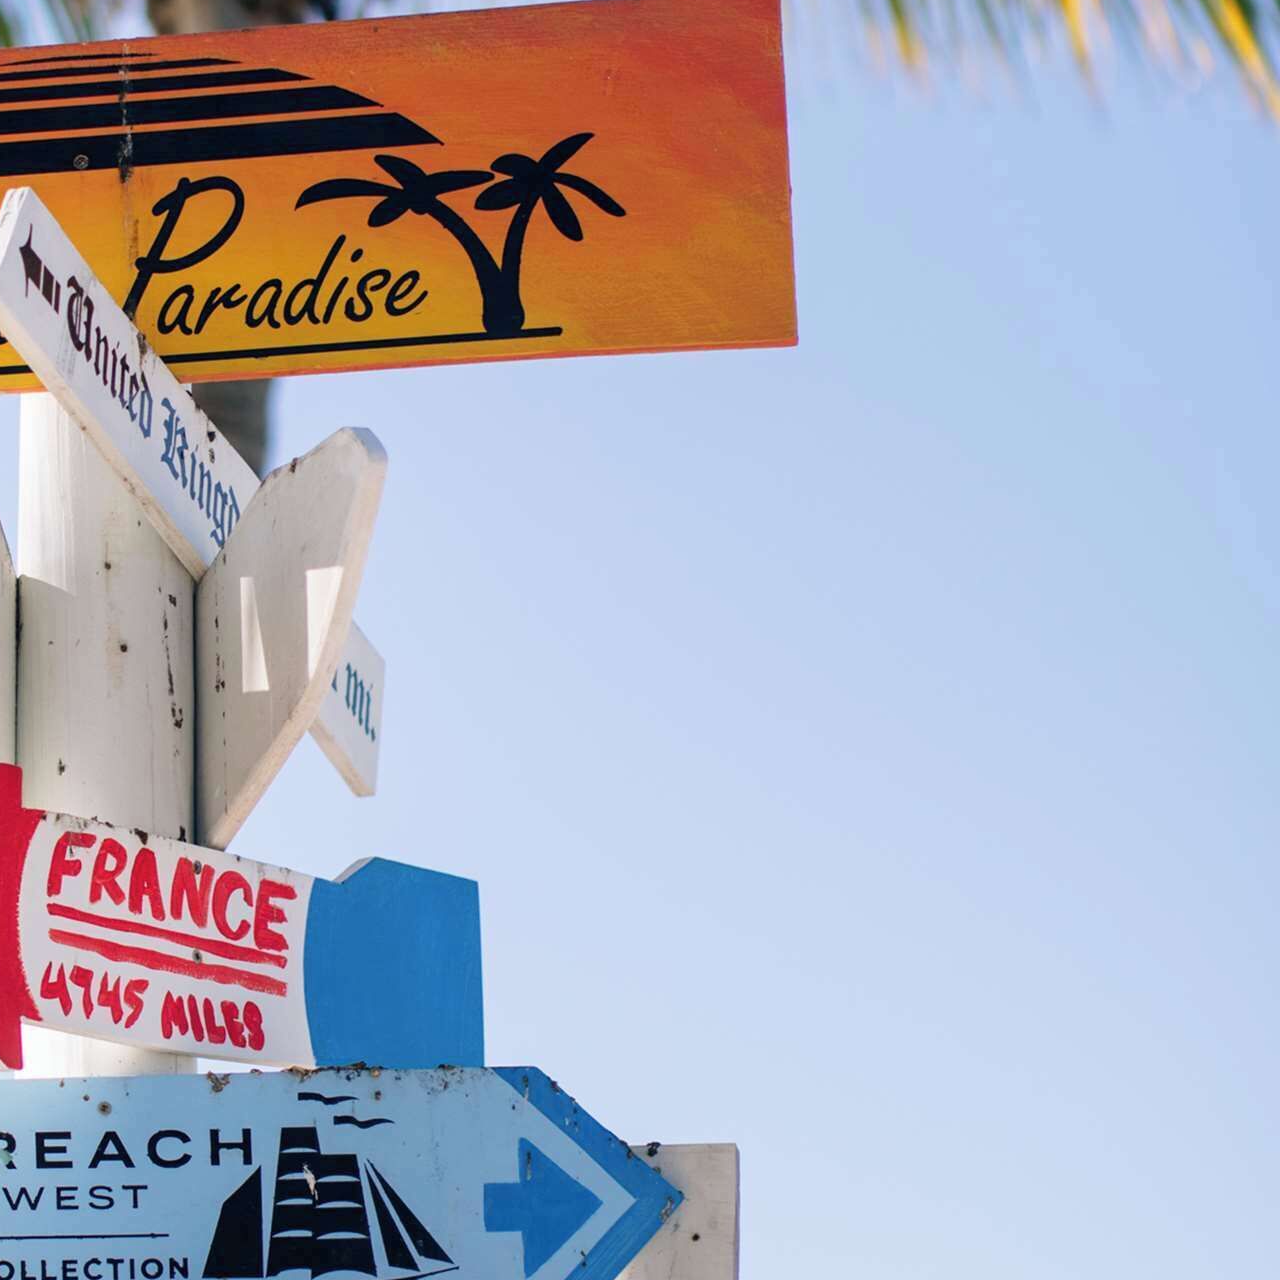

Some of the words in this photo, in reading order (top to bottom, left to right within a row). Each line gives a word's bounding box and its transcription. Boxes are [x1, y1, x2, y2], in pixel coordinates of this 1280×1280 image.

[120, 175, 429, 337] Paradise
[66, 275, 154, 439] United
[47, 831, 298, 951] FRANCE
[160, 989, 266, 1052] MILES
[1, 1184, 148, 1212] WEST
